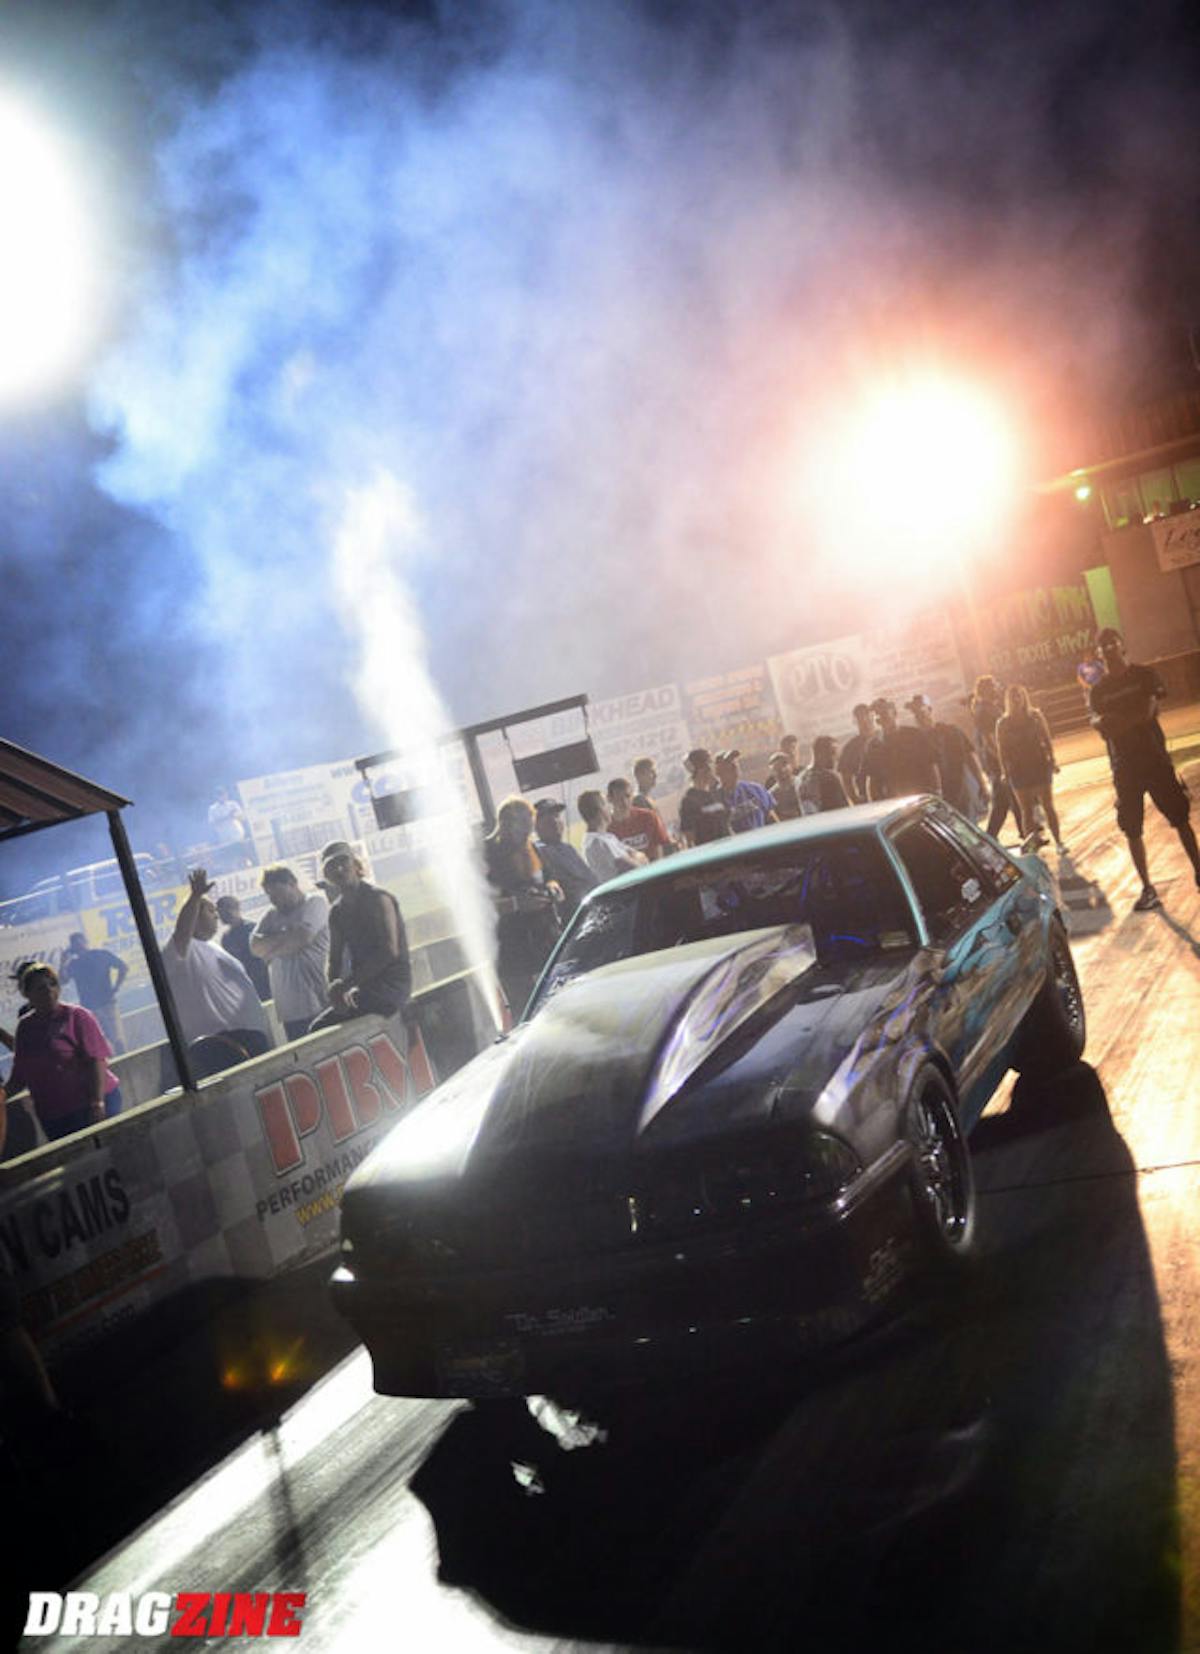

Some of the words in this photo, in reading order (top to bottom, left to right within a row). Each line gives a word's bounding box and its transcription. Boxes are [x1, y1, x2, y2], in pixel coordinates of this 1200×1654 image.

[789, 655, 854, 703] PTC
[253, 1024, 438, 1178] PBM
[32, 1167, 131, 1259] CAMS
